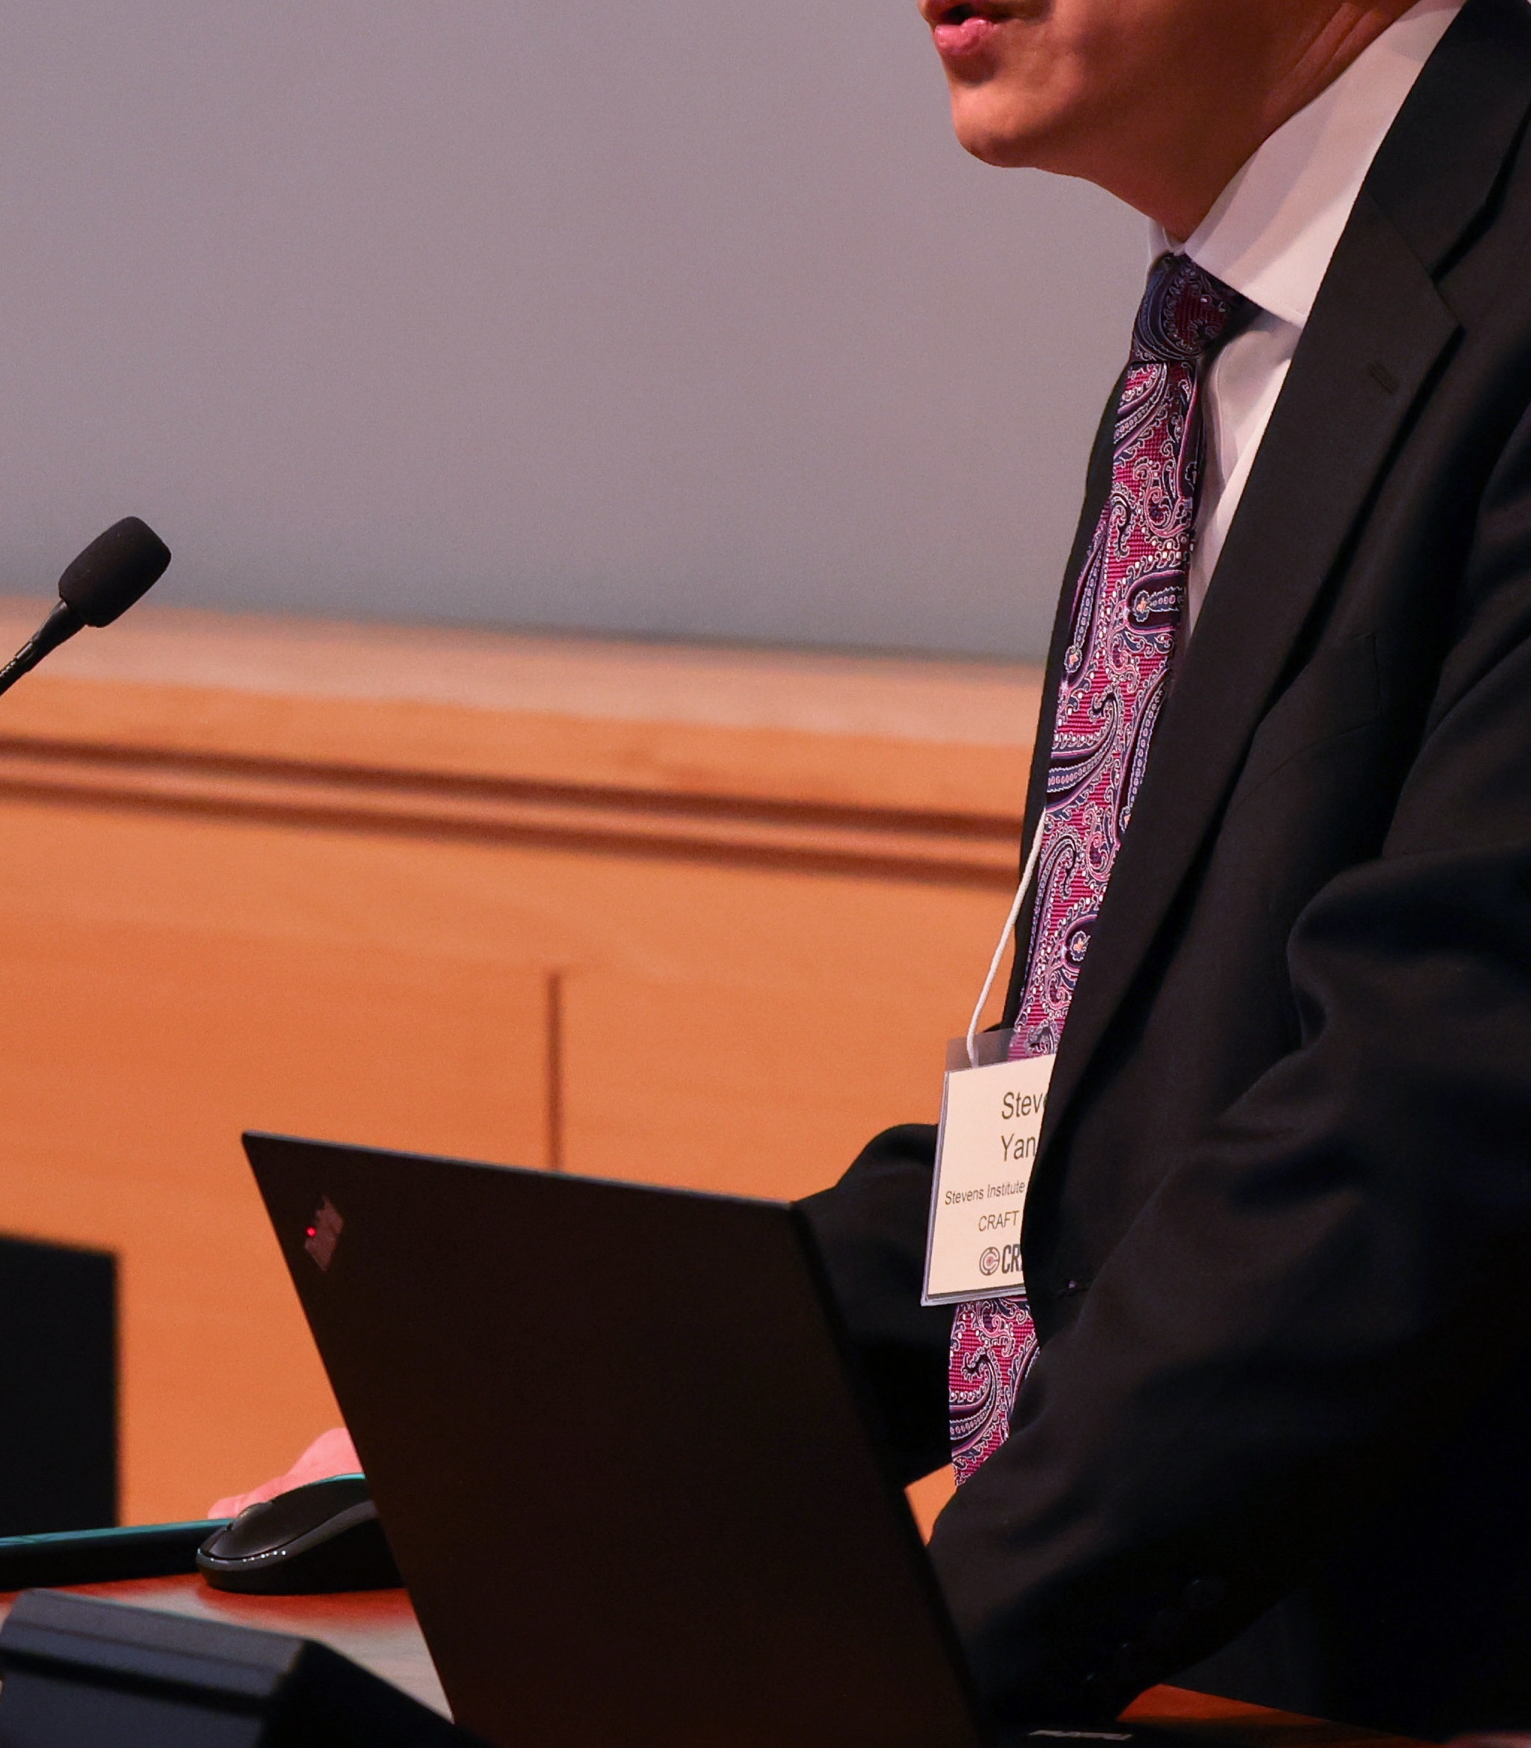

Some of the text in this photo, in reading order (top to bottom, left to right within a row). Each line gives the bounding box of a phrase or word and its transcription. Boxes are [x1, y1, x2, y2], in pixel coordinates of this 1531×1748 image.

[1001, 1133, 1038, 1162] Yan
[945, 1180, 1026, 1206] Stevens Institute
[978, 1210, 1019, 1232] CRAFT
[1001, 1243, 1023, 1274] CR
